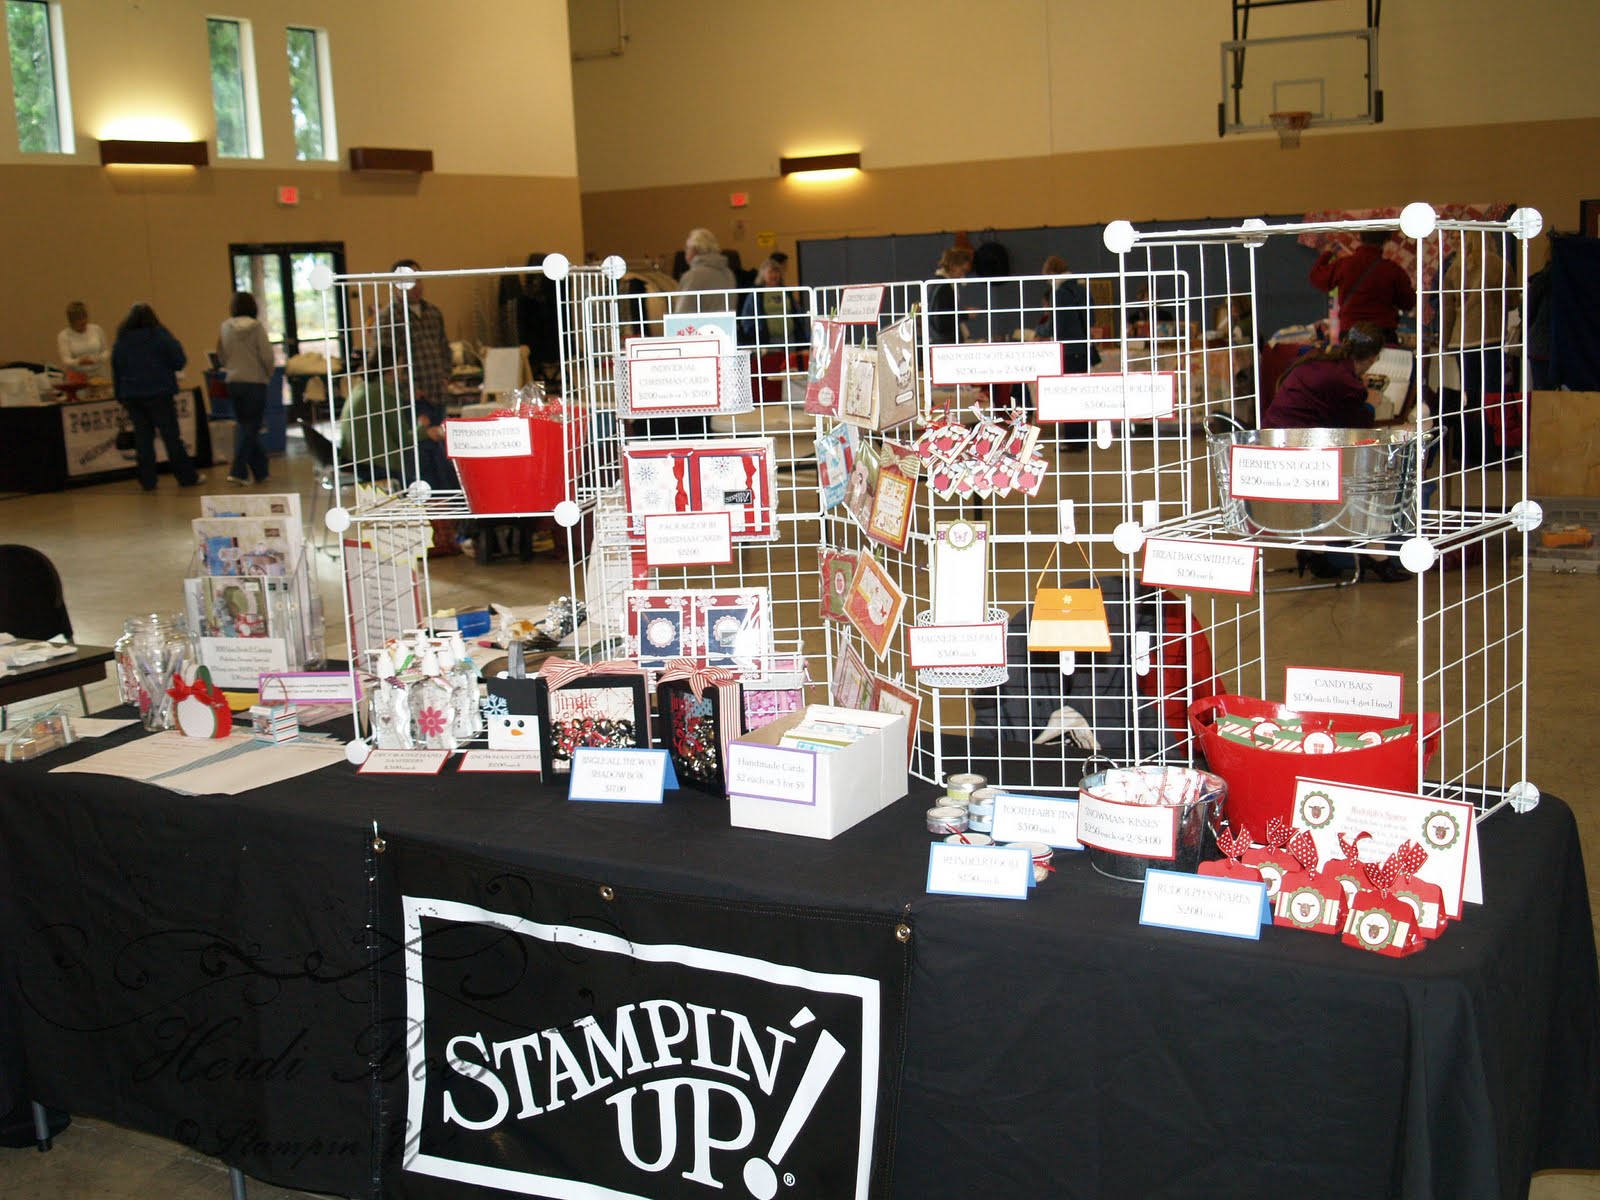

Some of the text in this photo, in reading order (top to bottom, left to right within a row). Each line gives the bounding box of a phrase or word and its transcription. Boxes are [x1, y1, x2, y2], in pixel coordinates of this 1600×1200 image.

[1179, 551, 1202, 562] BAGS
[1314, 678, 1373, 691] CANDY BAGS
[736, 757, 806, 774] Handmade Cards
[736, 772, 746, 782] $2
[747, 774, 765, 785] each
[1084, 806, 1125, 825] SNOWMAN
[443, 999, 816, 1131] STAMPIN'
